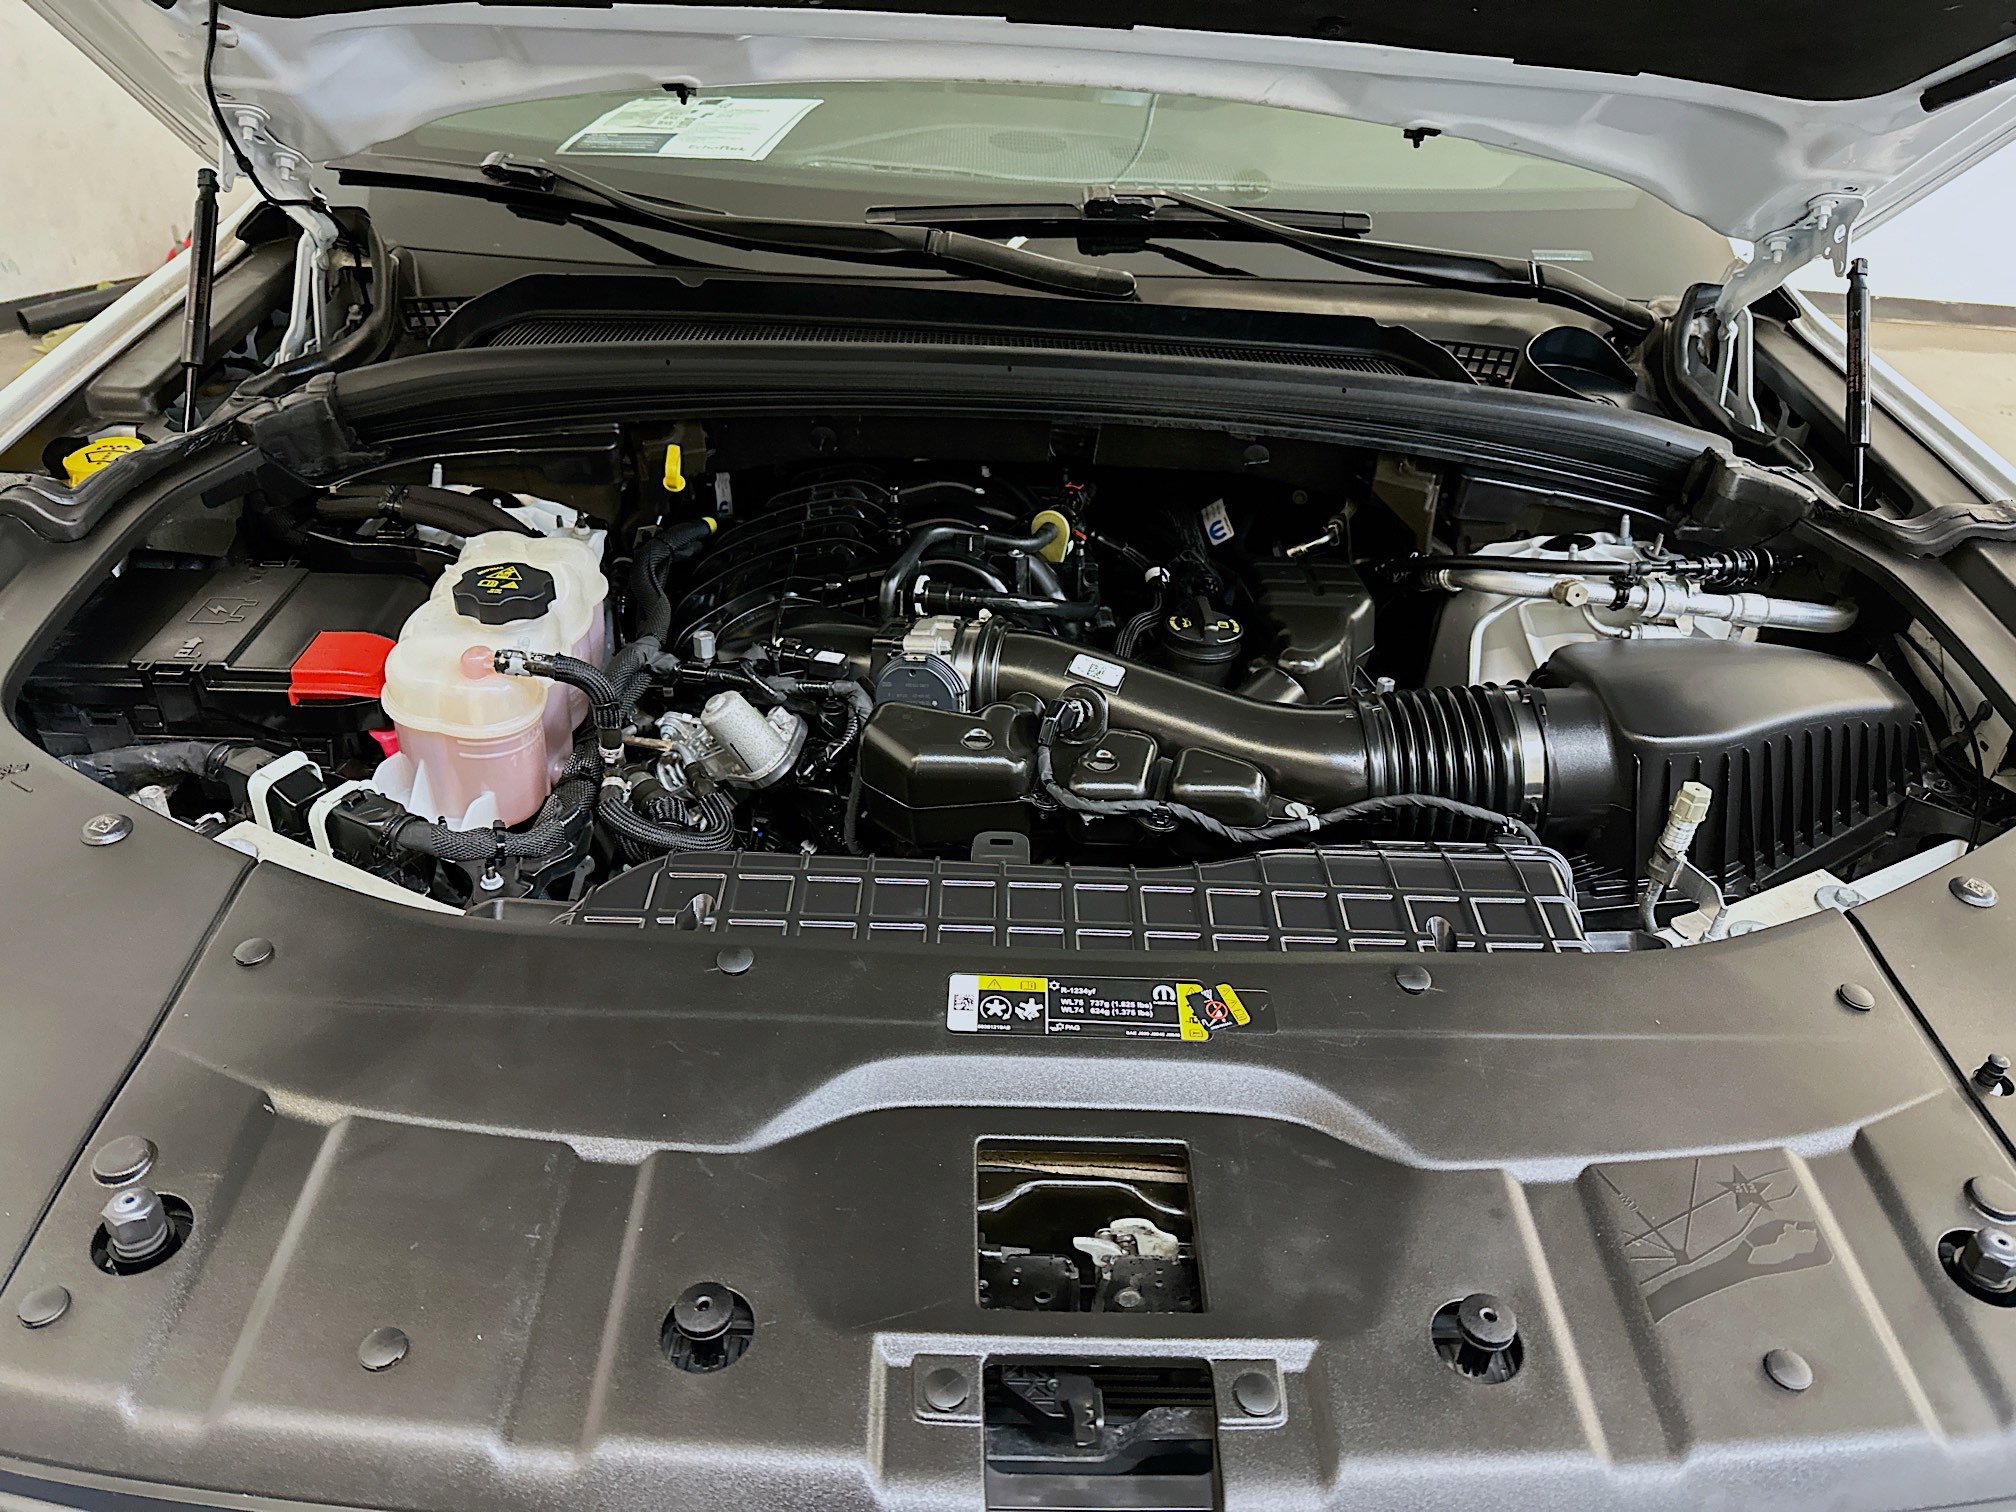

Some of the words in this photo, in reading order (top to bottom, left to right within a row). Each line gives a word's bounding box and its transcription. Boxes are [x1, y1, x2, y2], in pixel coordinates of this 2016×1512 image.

[1060, 986, 1097, 997] R-1234yf
[1089, 999, 1110, 1009] 737g
[1060, 1006, 1085, 1014] WL74
[1733, 1182, 1757, 1194] 313
